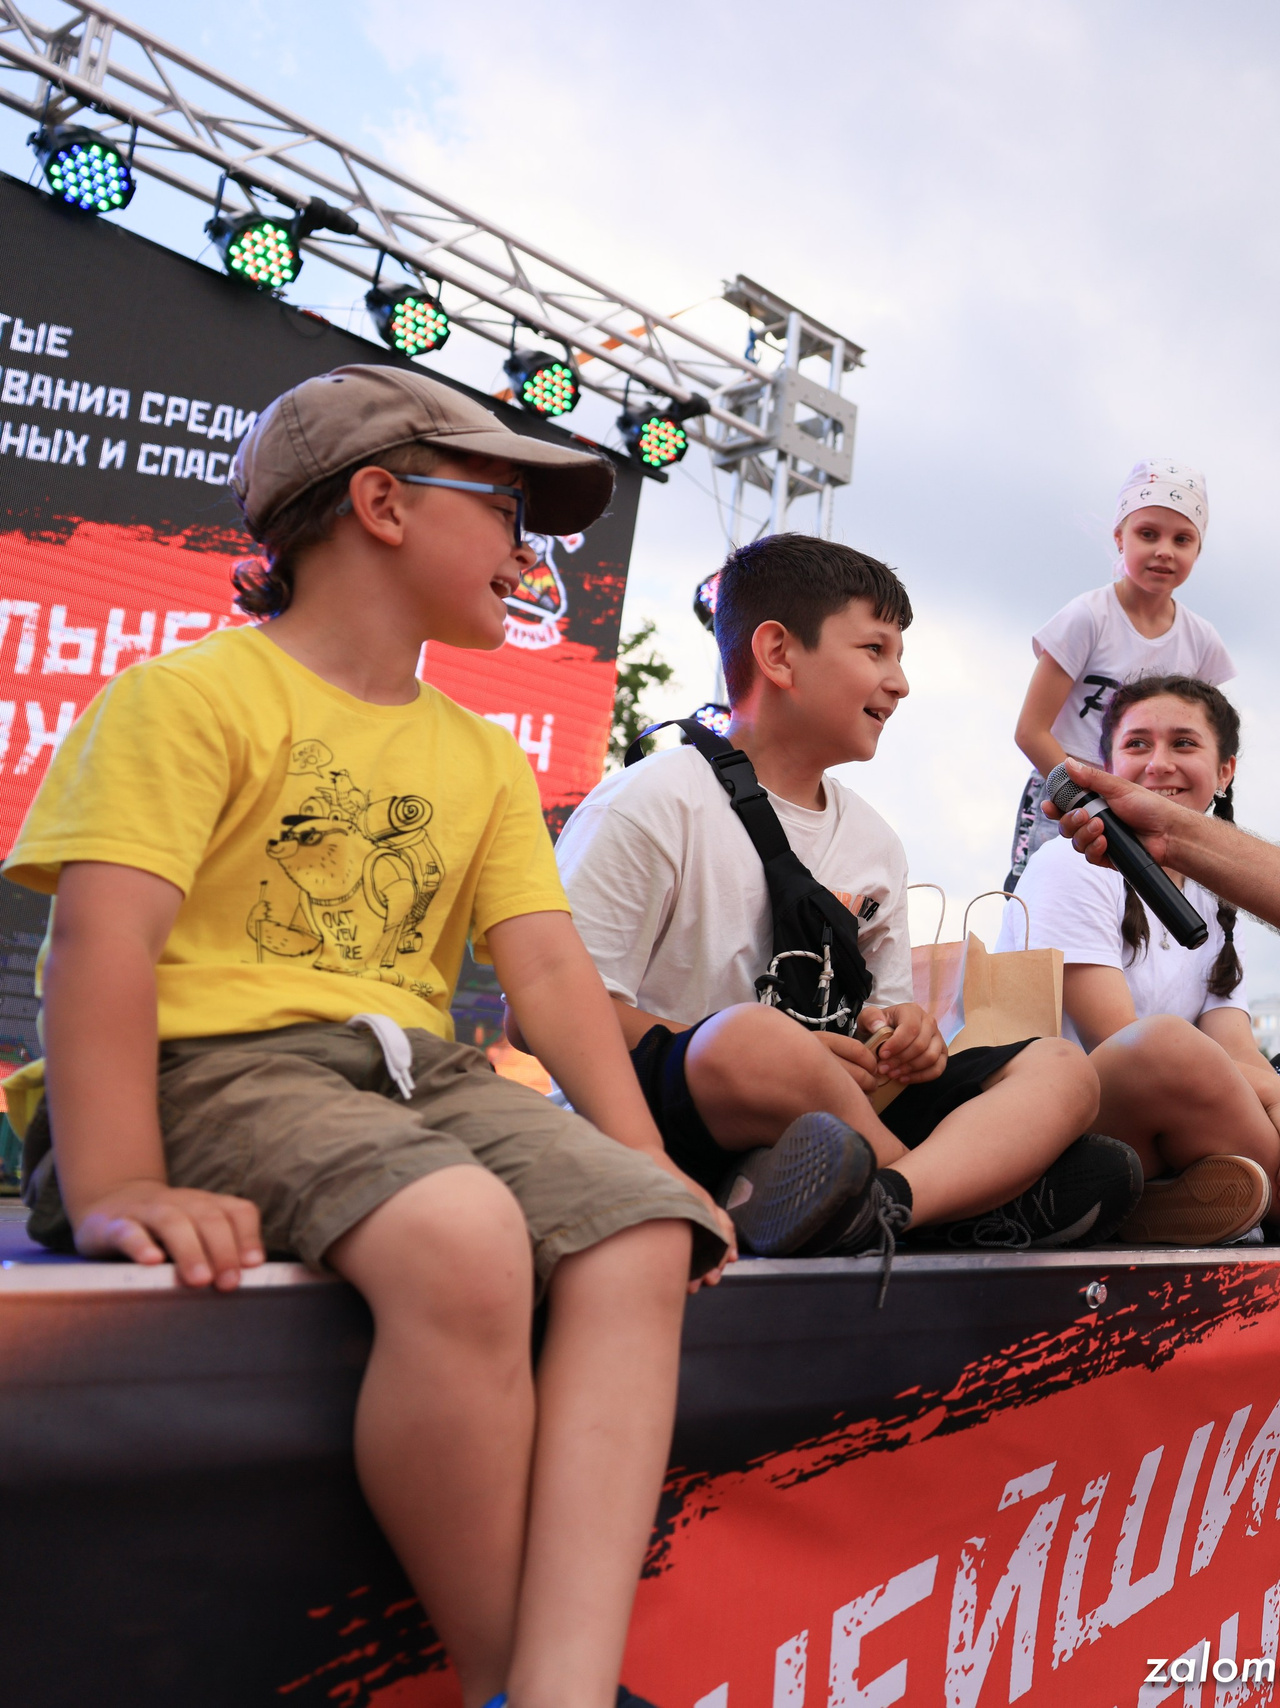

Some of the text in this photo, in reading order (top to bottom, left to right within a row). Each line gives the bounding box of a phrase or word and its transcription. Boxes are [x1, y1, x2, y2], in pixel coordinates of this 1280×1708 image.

[0, 366, 131, 420] ВАНИЯ
[0, 421, 239, 486] НЫХ И СПАС
[322, 910, 354, 928] OUT
